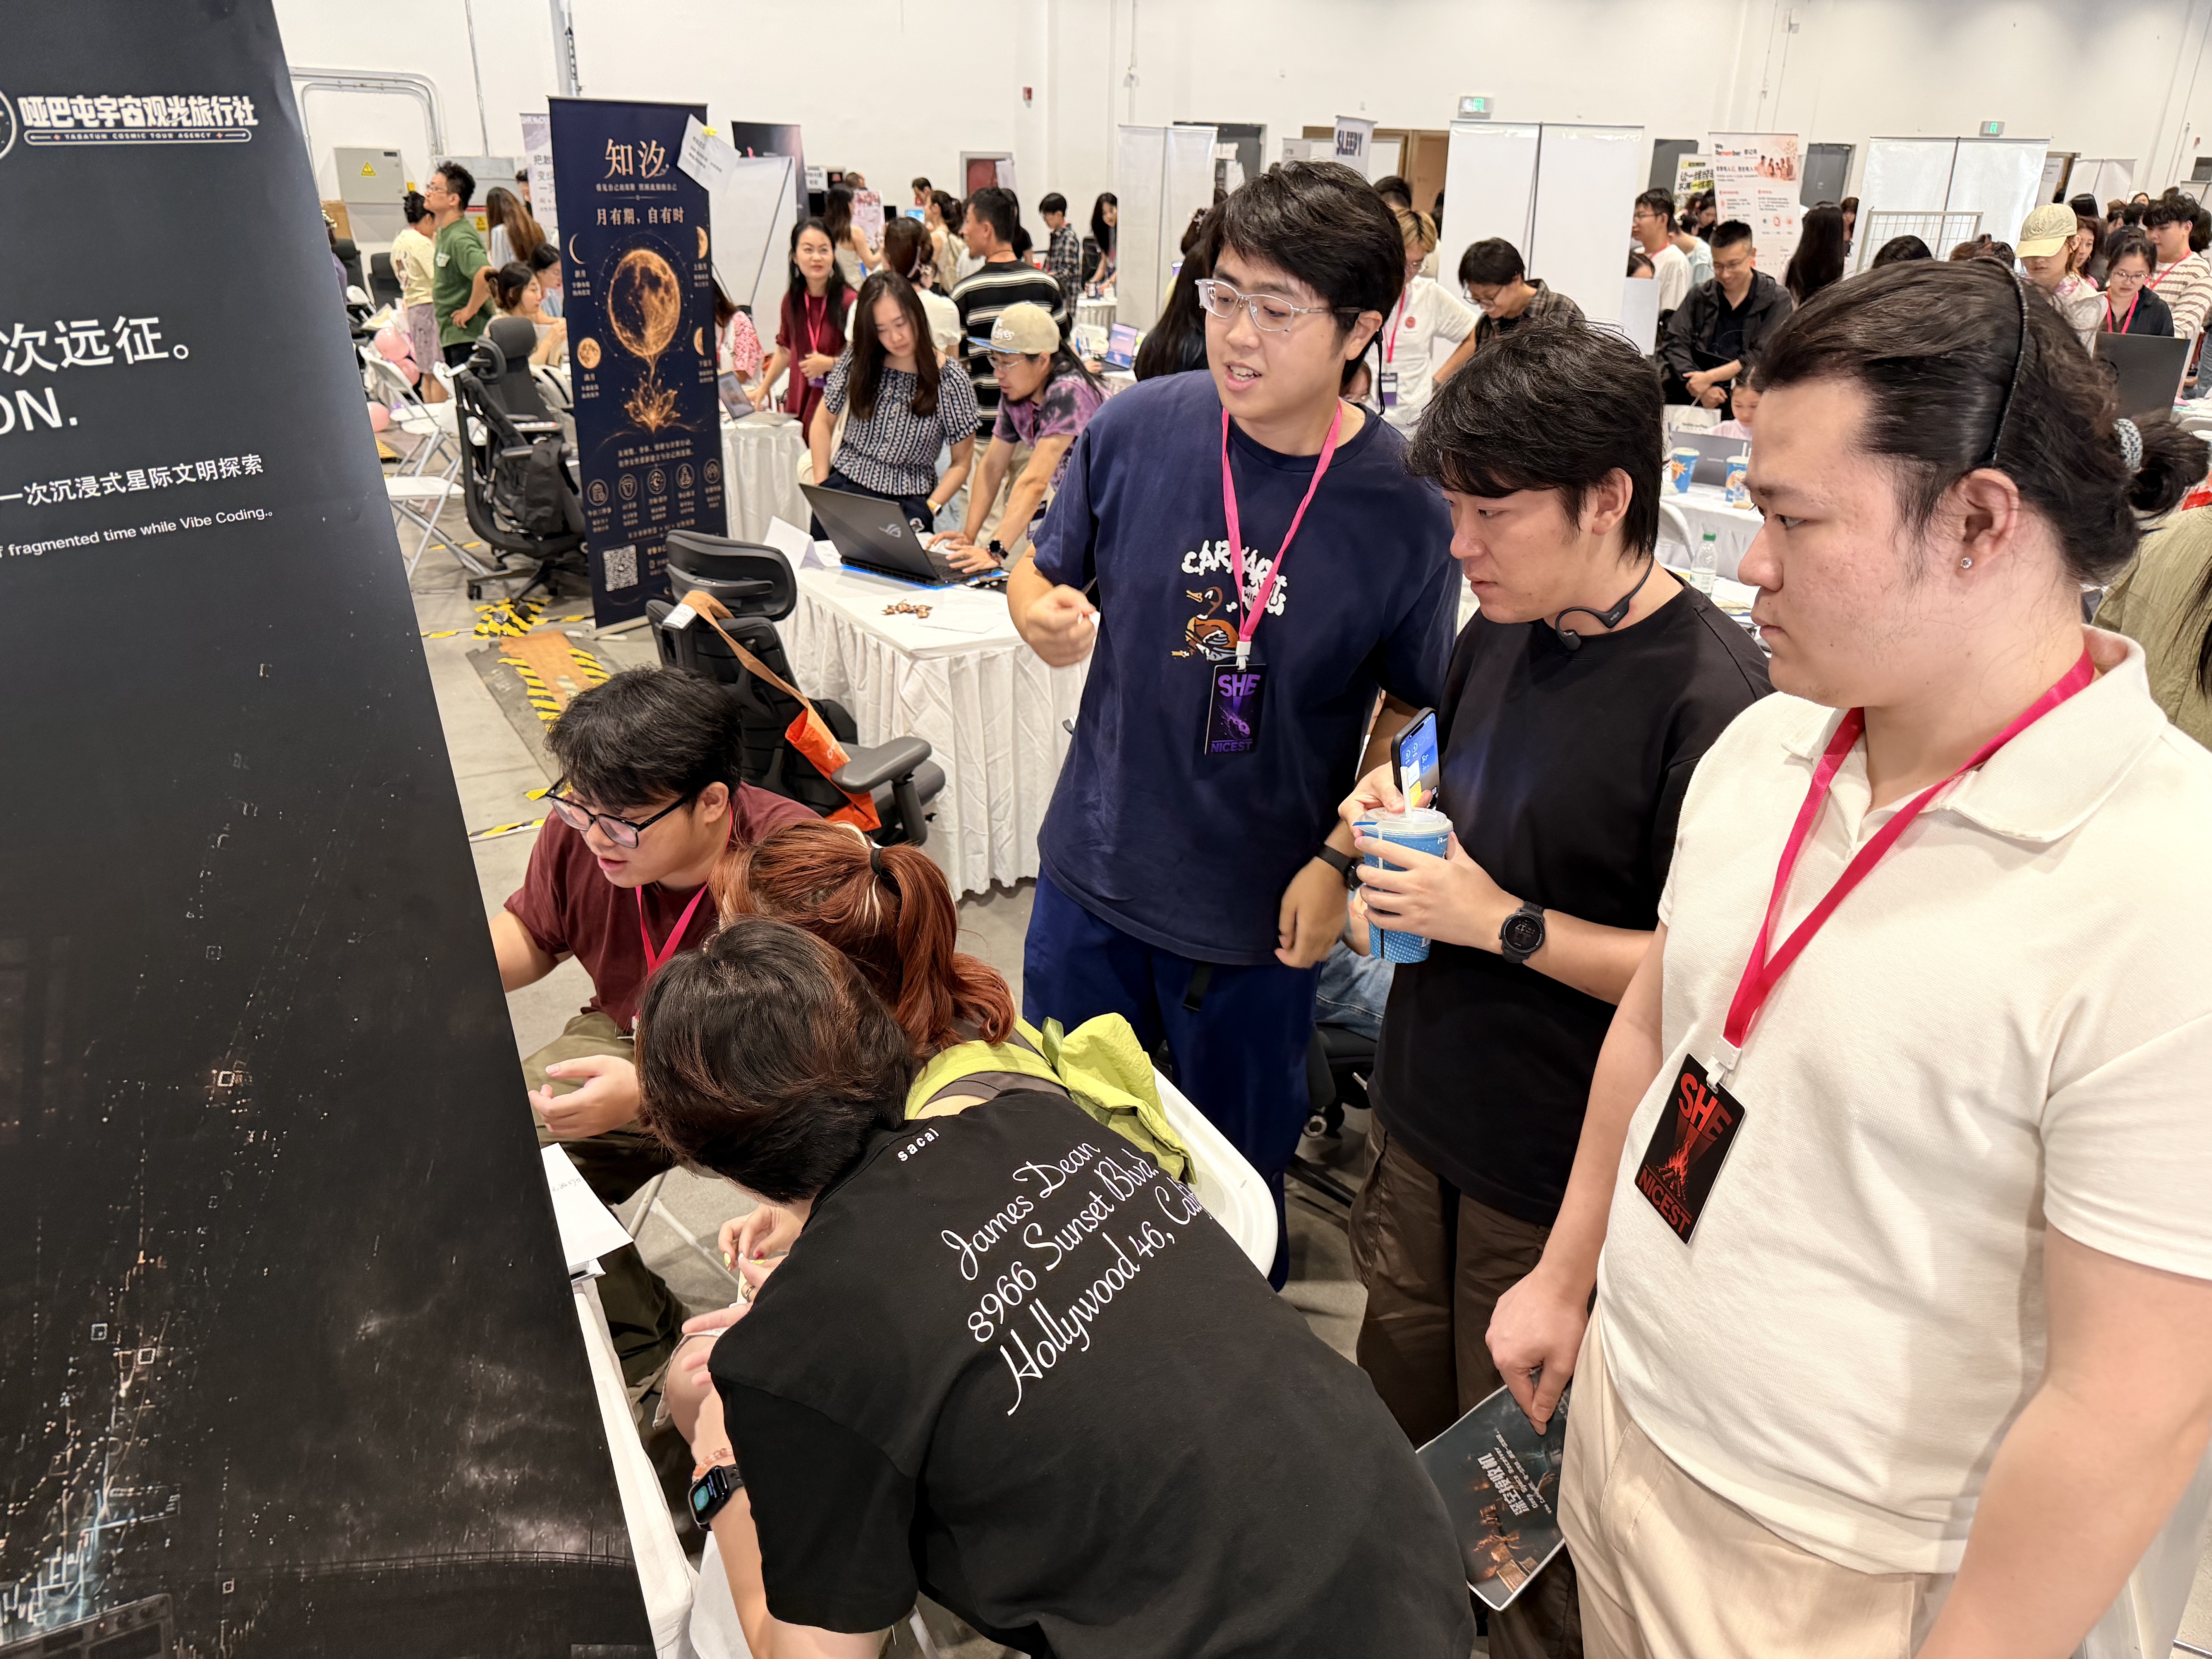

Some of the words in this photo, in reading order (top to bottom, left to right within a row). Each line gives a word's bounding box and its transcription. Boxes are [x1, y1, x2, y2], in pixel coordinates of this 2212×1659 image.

[17, 95, 259, 128] 哑巴屯宇宙观光旅行社
[604, 138, 667, 179] 知汐
[8, 531, 100, 556] fragmented
[103, 529, 137, 541] time
[140, 521, 177, 535] while
[180, 517, 212, 529] Vibe
[1218, 674, 1261, 697] SHE
[1211, 741, 1253, 753] NICEST
[1678, 1073, 1732, 1142] SHE
[941, 1195, 1034, 1281] James
[1013, 1142, 1101, 1199] Dean
[1638, 1168, 1691, 1234] NICEST
[968, 1261, 1037, 1343] 8966
[1024, 1191, 1115, 1271] Sunset
[1094, 1148, 1159, 1201] Blvd.
[1000, 1232, 1140, 1416] Hollywood
[1129, 1221, 1175, 1258] 46,
[1494, 1447, 1515, 1474] Receiver
[1477, 1452, 1530, 1516] 深空接收机
[1513, 1474, 1528, 1493] Space
